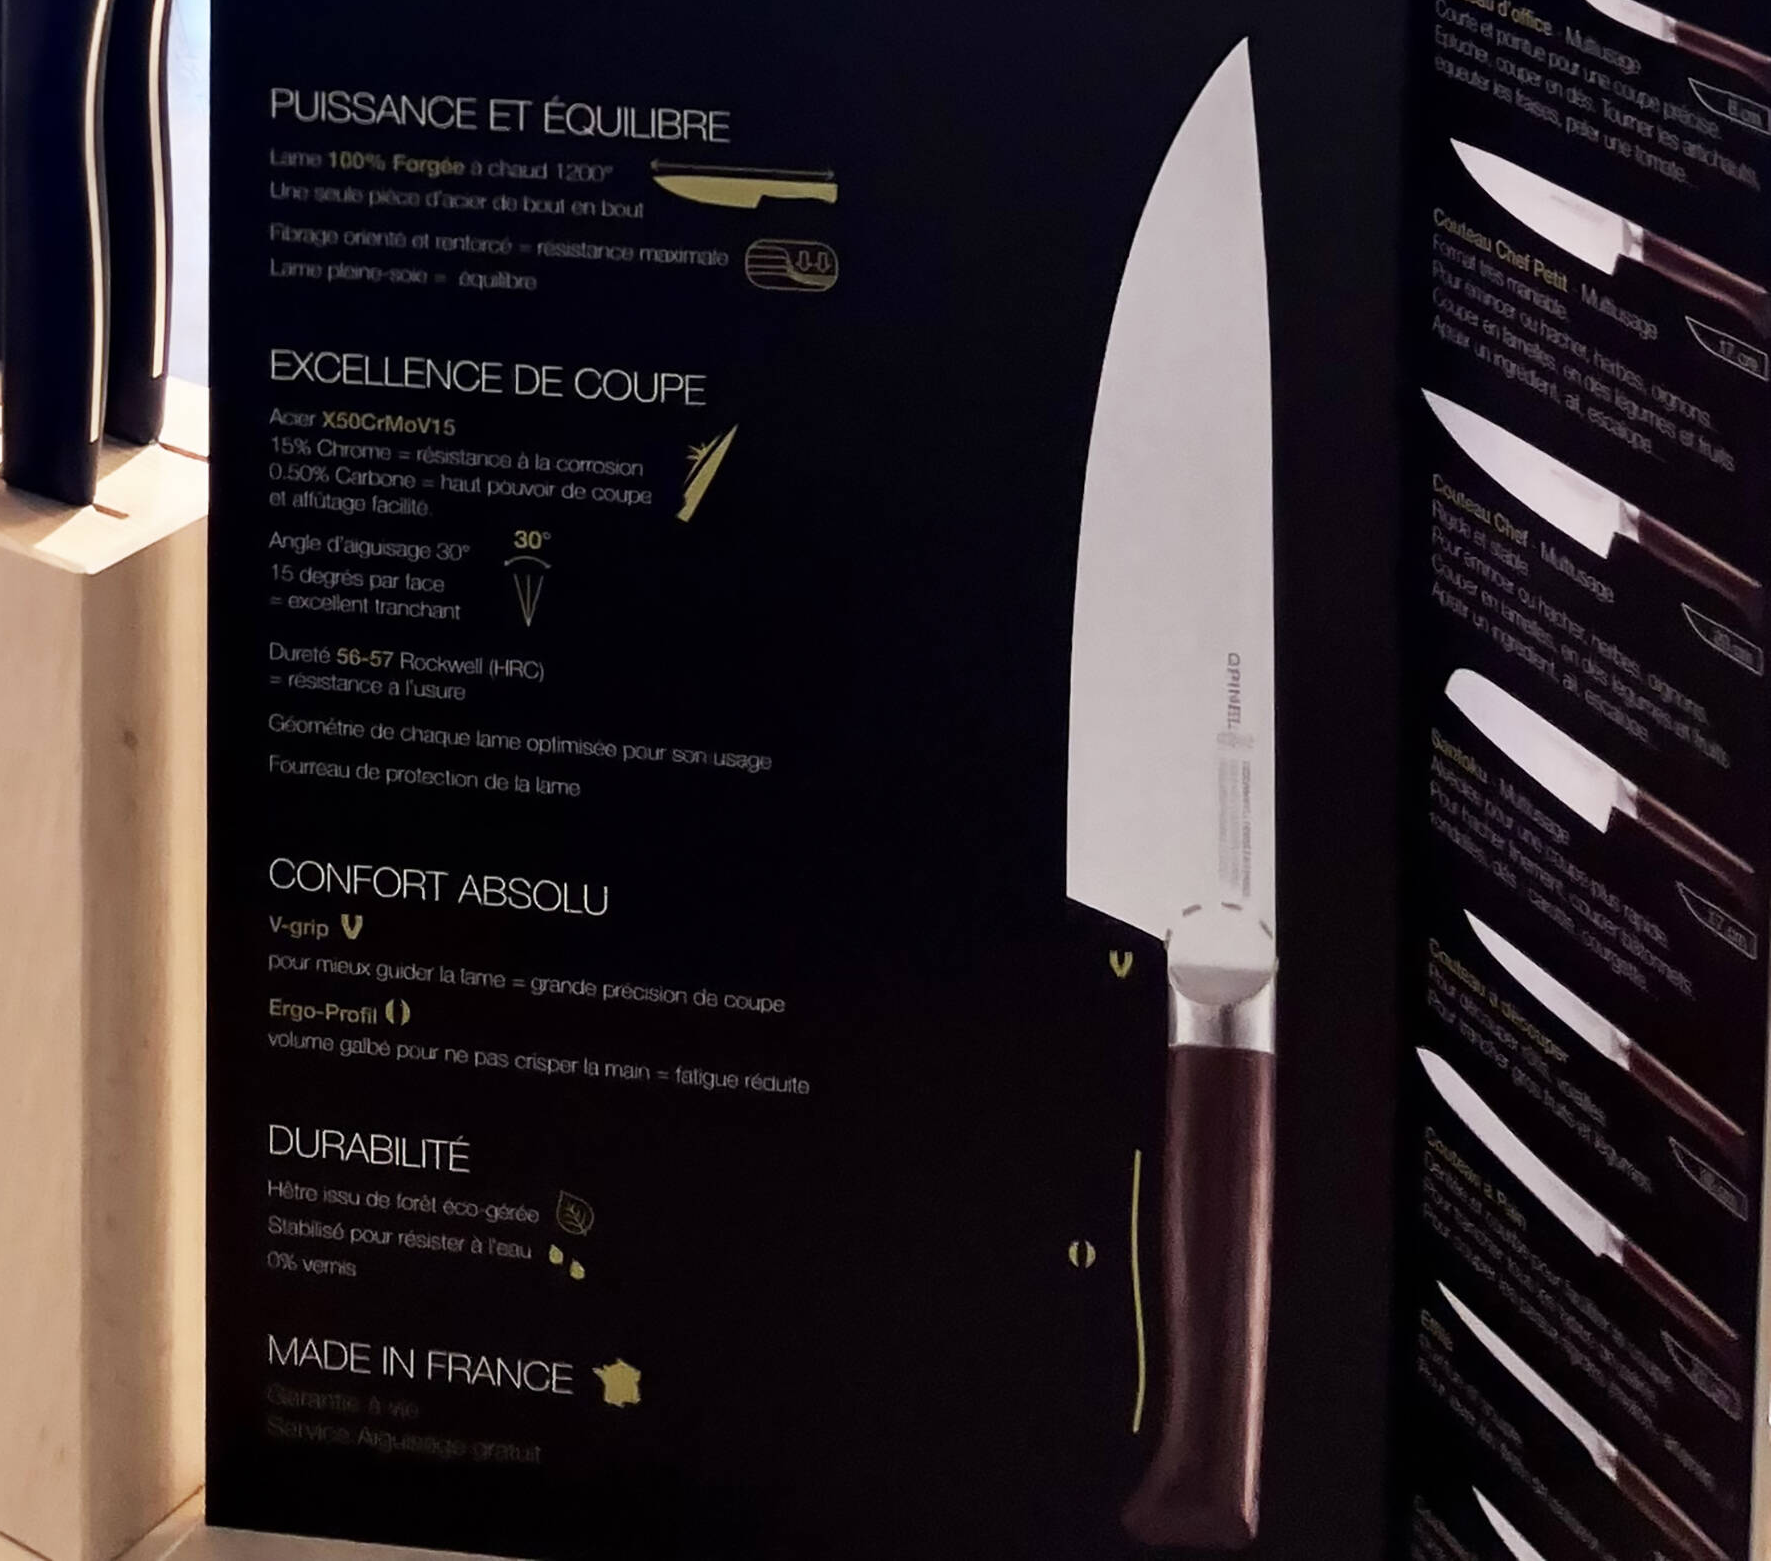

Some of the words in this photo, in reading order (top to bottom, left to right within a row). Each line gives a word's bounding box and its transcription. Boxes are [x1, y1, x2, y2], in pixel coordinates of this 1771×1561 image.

[270, 88, 477, 130] PUISSANCE
[489, 98, 533, 132] ET
[543, 95, 731, 143] ÉQUILIBRE
[269, 148, 323, 167] Lame
[328, 150, 386, 172] 100%
[392, 153, 466, 179] Forgée
[487, 159, 548, 180] chaud
[269, 181, 310, 201] Une
[313, 186, 364, 203] seule
[424, 190, 488, 210] d'acier
[491, 193, 518, 212] de
[522, 196, 565, 214] bout
[570, 200, 597, 216] en
[600, 199, 644, 219] bout
[269, 222, 339, 248] Fibrage
[411, 232, 430, 250] et
[536, 241, 635, 262] résistance
[1433, 207, 1491, 252] Couteau
[1495, 239, 1530, 271] Chef
[1533, 258, 1567, 292] Petit
[269, 258, 323, 278] Lame
[270, 348, 503, 394] EXCELLENCE
[514, 364, 564, 398] DE
[574, 367, 707, 406] COUPE
[322, 410, 456, 437] X50CrMoV15
[271, 435, 312, 455] 15%
[316, 438, 392, 461] Chrome
[416, 446, 512, 469] résistance
[534, 453, 551, 471] la
[555, 458, 644, 476] corrosion
[268, 490, 286, 507] et
[334, 466, 417, 490] Carbone
[440, 474, 482, 493] haut
[486, 480, 556, 498] pouvoir
[560, 482, 587, 500] de
[591, 487, 653, 507] coupe
[268, 531, 322, 555] Angle
[514, 530, 552, 550] 30°
[272, 563, 295, 582] 15
[299, 566, 365, 590] degrés
[369, 574, 400, 592] par
[405, 573, 445, 593] face
[287, 593, 369, 614] excellent
[374, 598, 461, 621] tranchant
[269, 642, 331, 664] Dureté
[336, 647, 395, 668] 56-57
[399, 651, 483, 675] Rockwell
[488, 658, 545, 683] (HRC)
[288, 672, 383, 694] résistance
[268, 712, 365, 738] Géométrie
[370, 723, 395, 741] de
[399, 725, 471, 748] chaque
[475, 730, 522, 751] lame
[526, 735, 618, 758] optimisée
[622, 744, 667, 763] pour
[713, 752, 773, 774] usage
[269, 754, 351, 779] Fourreau
[355, 762, 381, 781] de
[385, 767, 479, 788] protection
[483, 773, 509, 791] de
[514, 774, 531, 793] la
[535, 775, 581, 797] lame
[269, 857, 449, 902] CONFORT
[457, 874, 609, 916] ABSOLU
[268, 915, 330, 941] V-grip
[268, 954, 311, 972] pour
[315, 958, 371, 977] mieux
[375, 963, 435, 983] guider
[439, 965, 456, 985] la
[459, 967, 506, 988] lame
[530, 976, 598, 997] grande
[602, 983, 688, 1004] précision
[692, 988, 719, 1008] de
[723, 994, 786, 1014] coupe
[269, 997, 378, 1024] Ergo-Profil
[267, 1030, 335, 1052] volume
[339, 1037, 391, 1057] galbé
[396, 1043, 440, 1061] pour
[444, 1048, 469, 1064] ne
[474, 1051, 510, 1068] pas
[514, 1053, 580, 1075] crisper
[583, 1057, 600, 1077] la
[604, 1063, 651, 1080] main
[675, 1065, 739, 1091] fatigue
[744, 1072, 810, 1095] réduite
[269, 1124, 470, 1173] DURABILITÉ
[267, 1180, 318, 1202] Hêtre
[323, 1186, 361, 1206] issu
[365, 1190, 391, 1209] de
[349, 1227, 394, 1245] pour
[397, 1229, 465, 1253] résister
[488, 1237, 532, 1259] l'eau
[268, 1334, 371, 1374] MADE
[382, 1345, 415, 1379] IN
[427, 1350, 573, 1394] FRANCE
